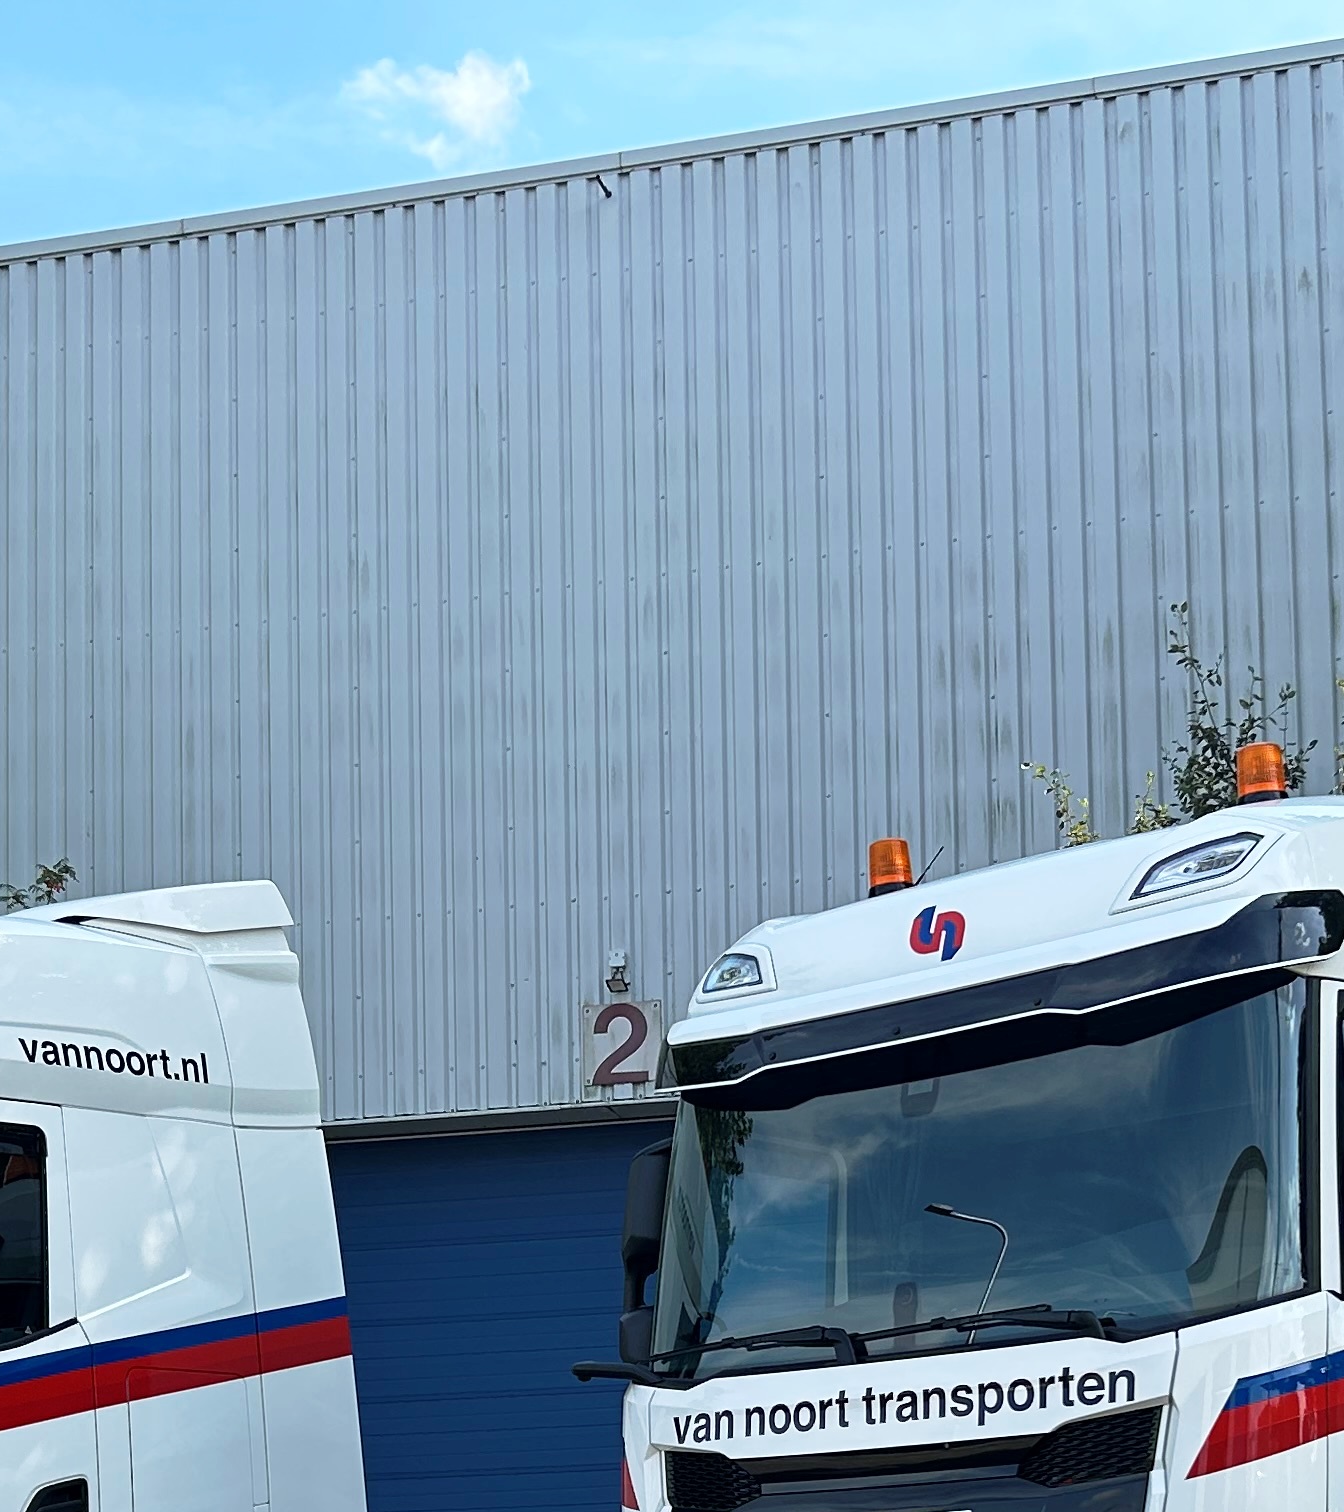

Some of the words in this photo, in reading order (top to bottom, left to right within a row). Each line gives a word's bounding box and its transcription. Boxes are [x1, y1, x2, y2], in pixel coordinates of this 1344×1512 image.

[17, 1037, 209, 1084] vannoort.nl
[592, 1003, 649, 1086] 2
[673, 1409, 734, 1445] van
[745, 1390, 850, 1437] noort
[861, 1366, 1136, 1427] transporten
